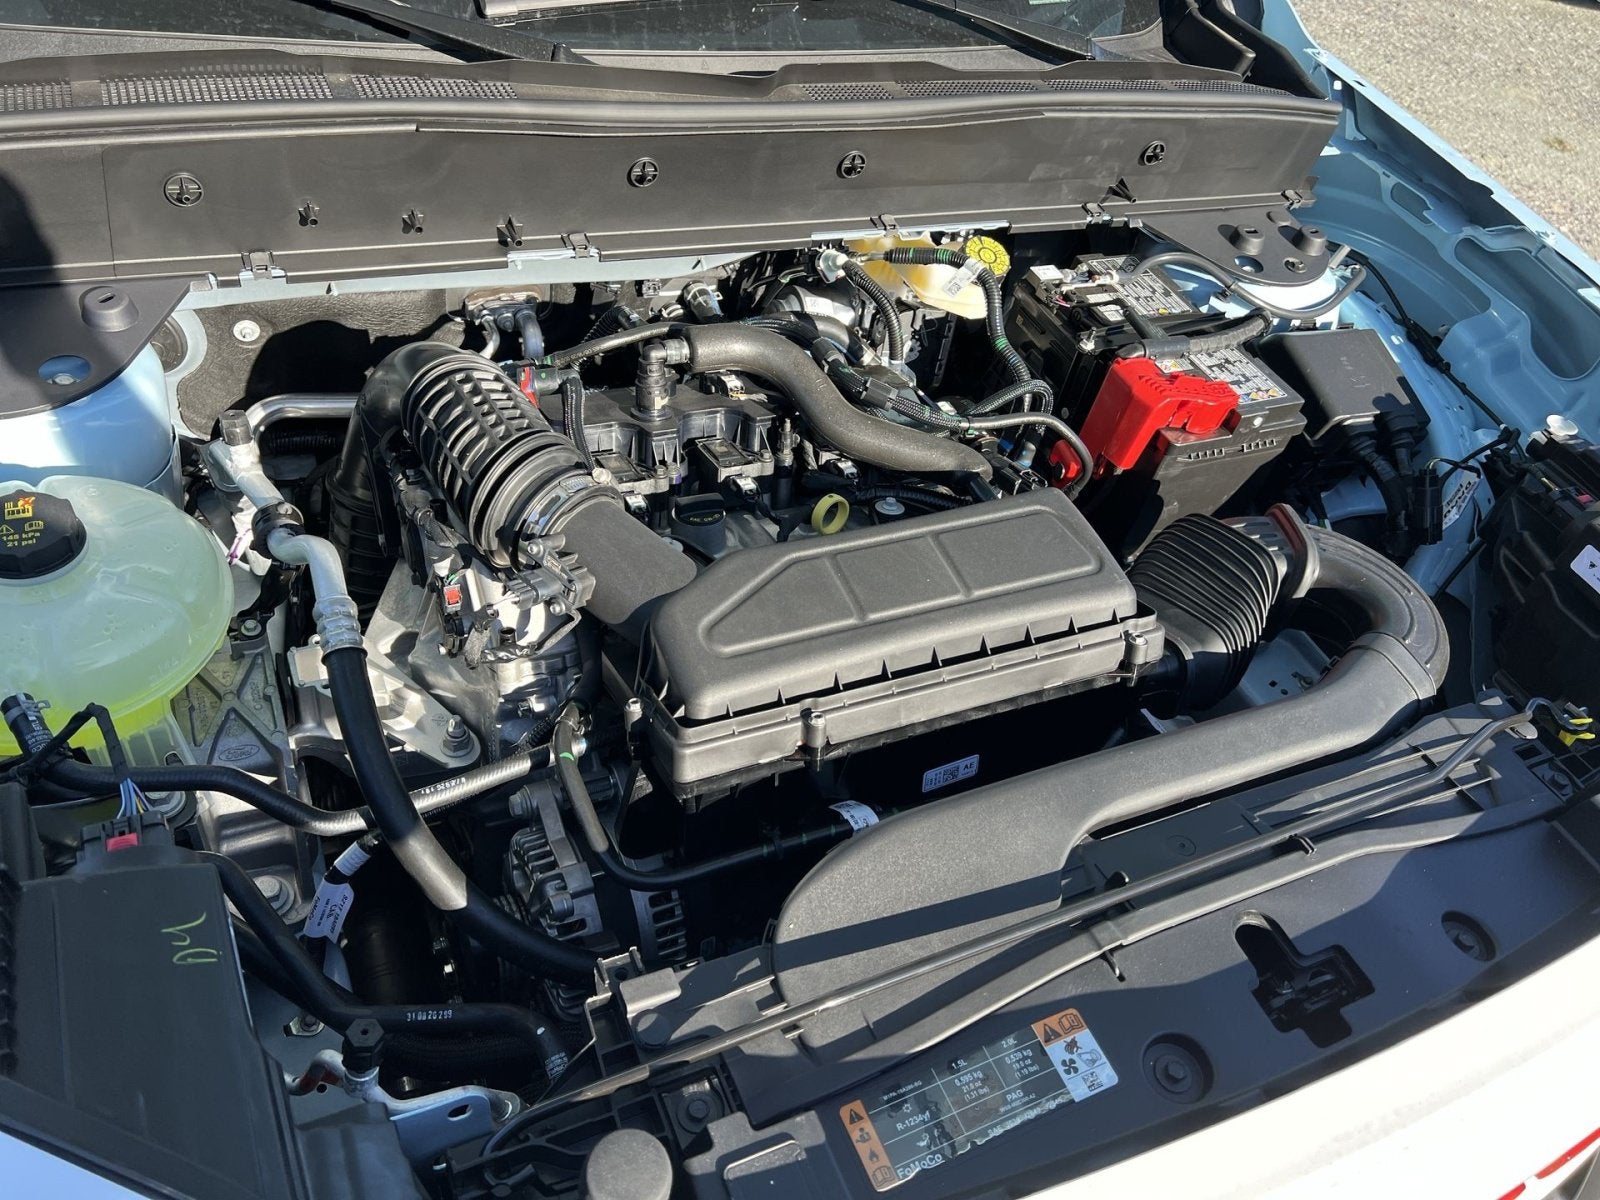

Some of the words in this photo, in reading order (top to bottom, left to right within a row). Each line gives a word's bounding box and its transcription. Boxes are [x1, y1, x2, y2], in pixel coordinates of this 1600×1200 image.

[22, 532, 41, 540] kPa
[21, 538, 37, 547] psi
[1001, 1038, 1017, 1048] 2.0L
[1022, 1048, 1033, 1058] kg
[951, 1058, 968, 1070] 1.5L
[1028, 1063, 1040, 1075] lbs)
[973, 1070, 983, 1080] kg
[978, 1086, 990, 1097] lbs)
[1005, 1089, 1024, 1102] PAG
[896, 1110, 931, 1131] R-1234yf
[896, 1152, 943, 1179] FoMoCo
